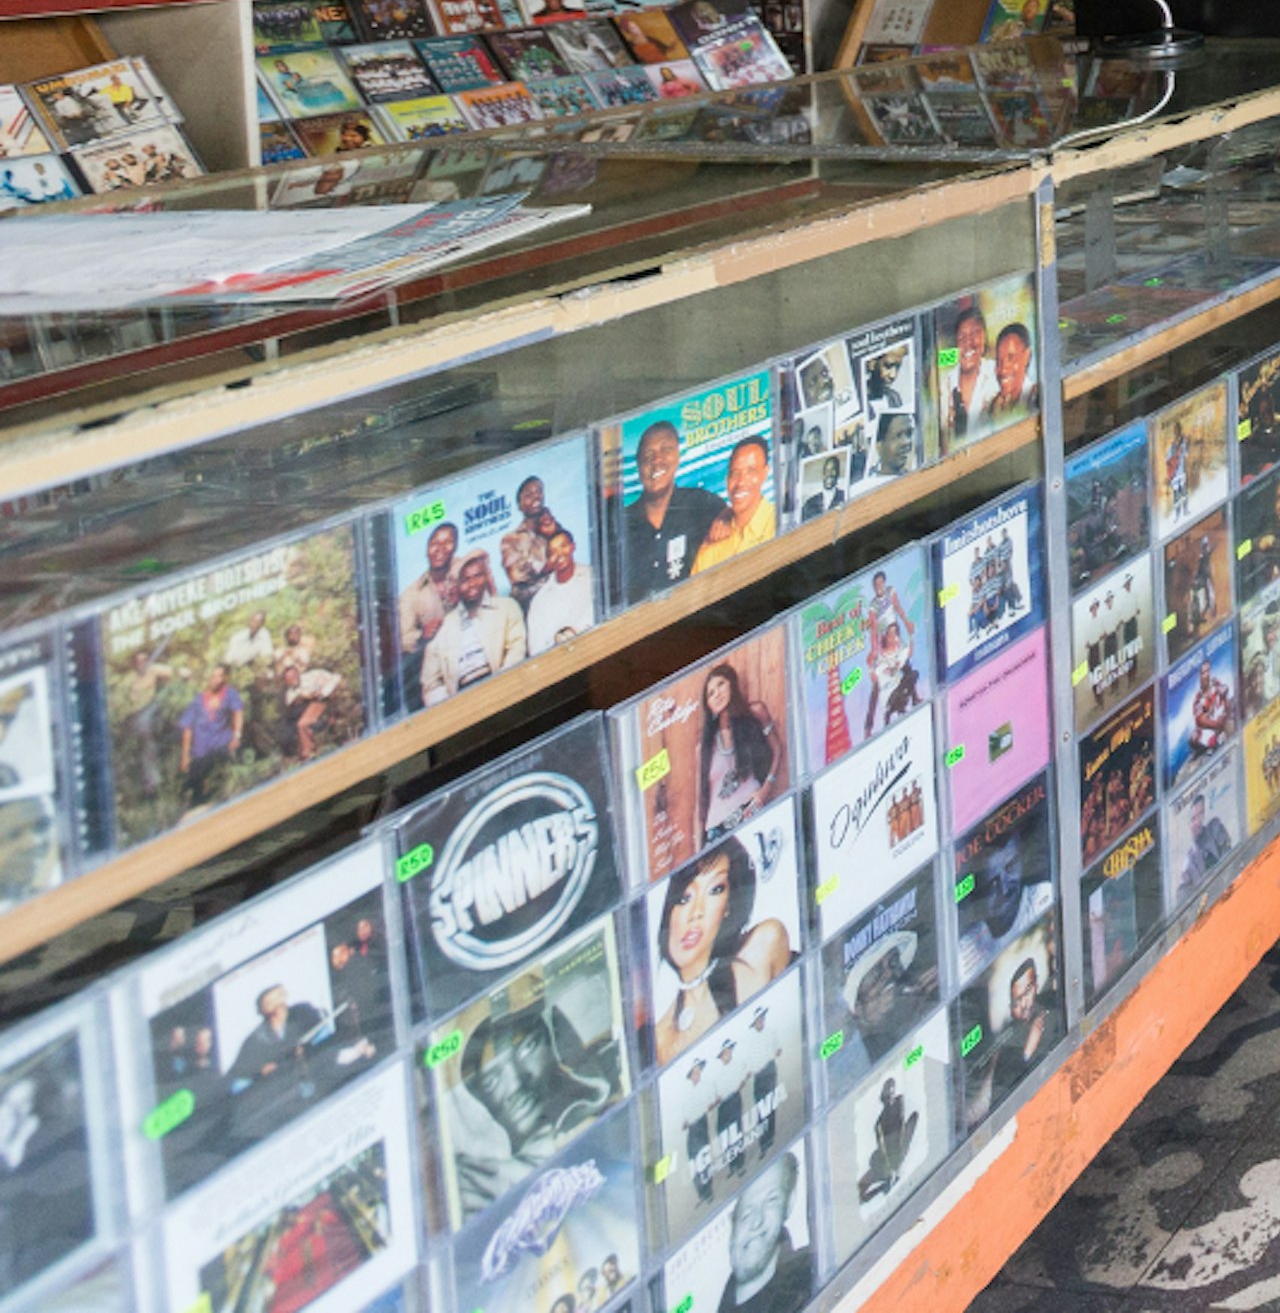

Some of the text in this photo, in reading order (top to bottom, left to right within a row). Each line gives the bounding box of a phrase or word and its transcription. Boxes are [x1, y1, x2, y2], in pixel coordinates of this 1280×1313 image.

[681, 377, 770, 433] SOUL
[685, 406, 768, 449] BROTHERS
[409, 503, 445, 531] R65
[463, 498, 512, 524] SOUL
[847, 602, 863, 621] of
[984, 786, 1047, 845] COCKER
[401, 848, 430, 874] R50
[430, 806, 599, 937] SPINNERS
[431, 1035, 459, 1060] R50
